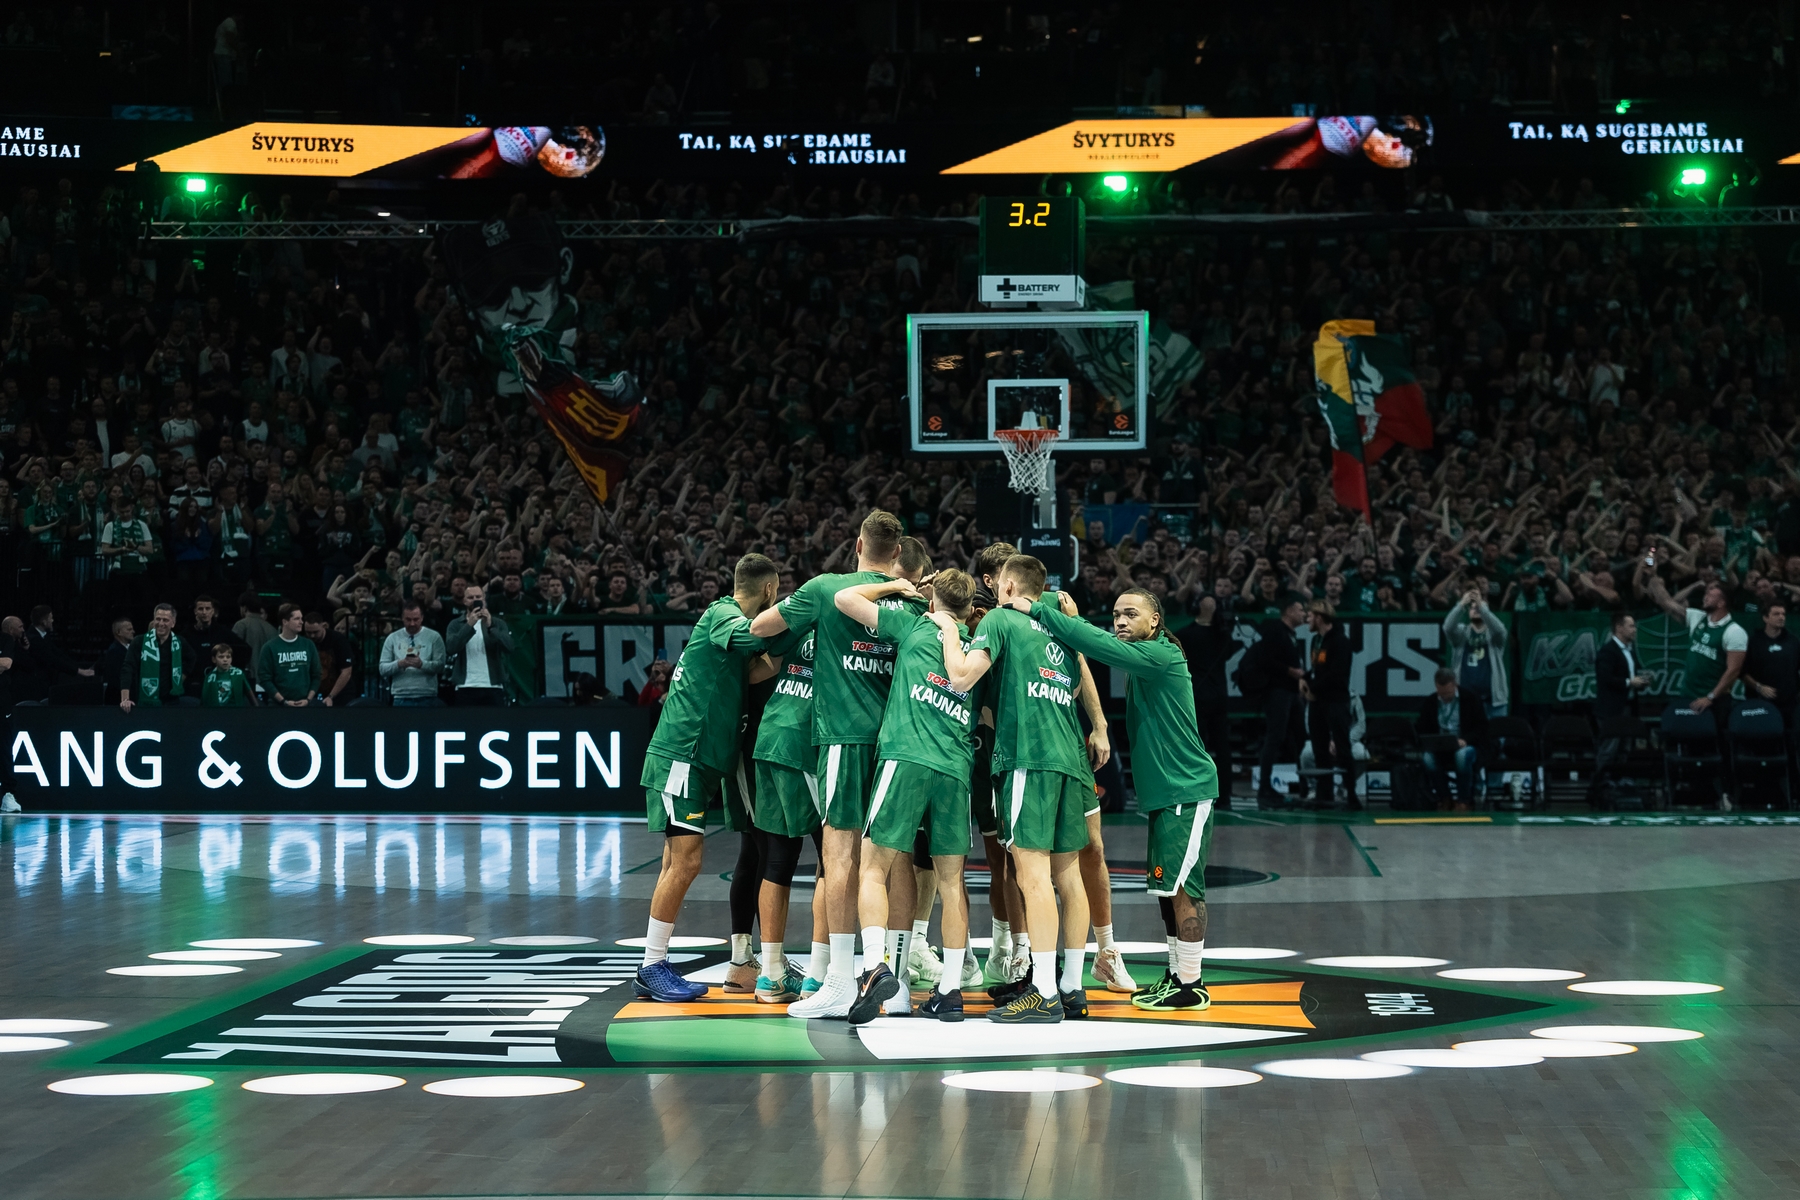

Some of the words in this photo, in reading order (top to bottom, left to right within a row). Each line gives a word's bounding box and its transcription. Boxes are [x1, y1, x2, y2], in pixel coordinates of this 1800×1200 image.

[1073, 131, 1175, 148] ŠVYTURYS
[1596, 123, 1708, 138] SUGEBAME
[252, 132, 354, 152] ŠVYTURYS
[1621, 138, 1744, 154] GERIAUSIAI
[1009, 203, 1050, 227] 3.2
[1018, 284, 1060, 292] BATTERY
[843, 655, 893, 676] KAUNA
[775, 679, 813, 700] KAUNA
[910, 684, 970, 725] KAUNAS
[198, 730, 243, 789] &
[267, 730, 621, 789] OLUFSEN
